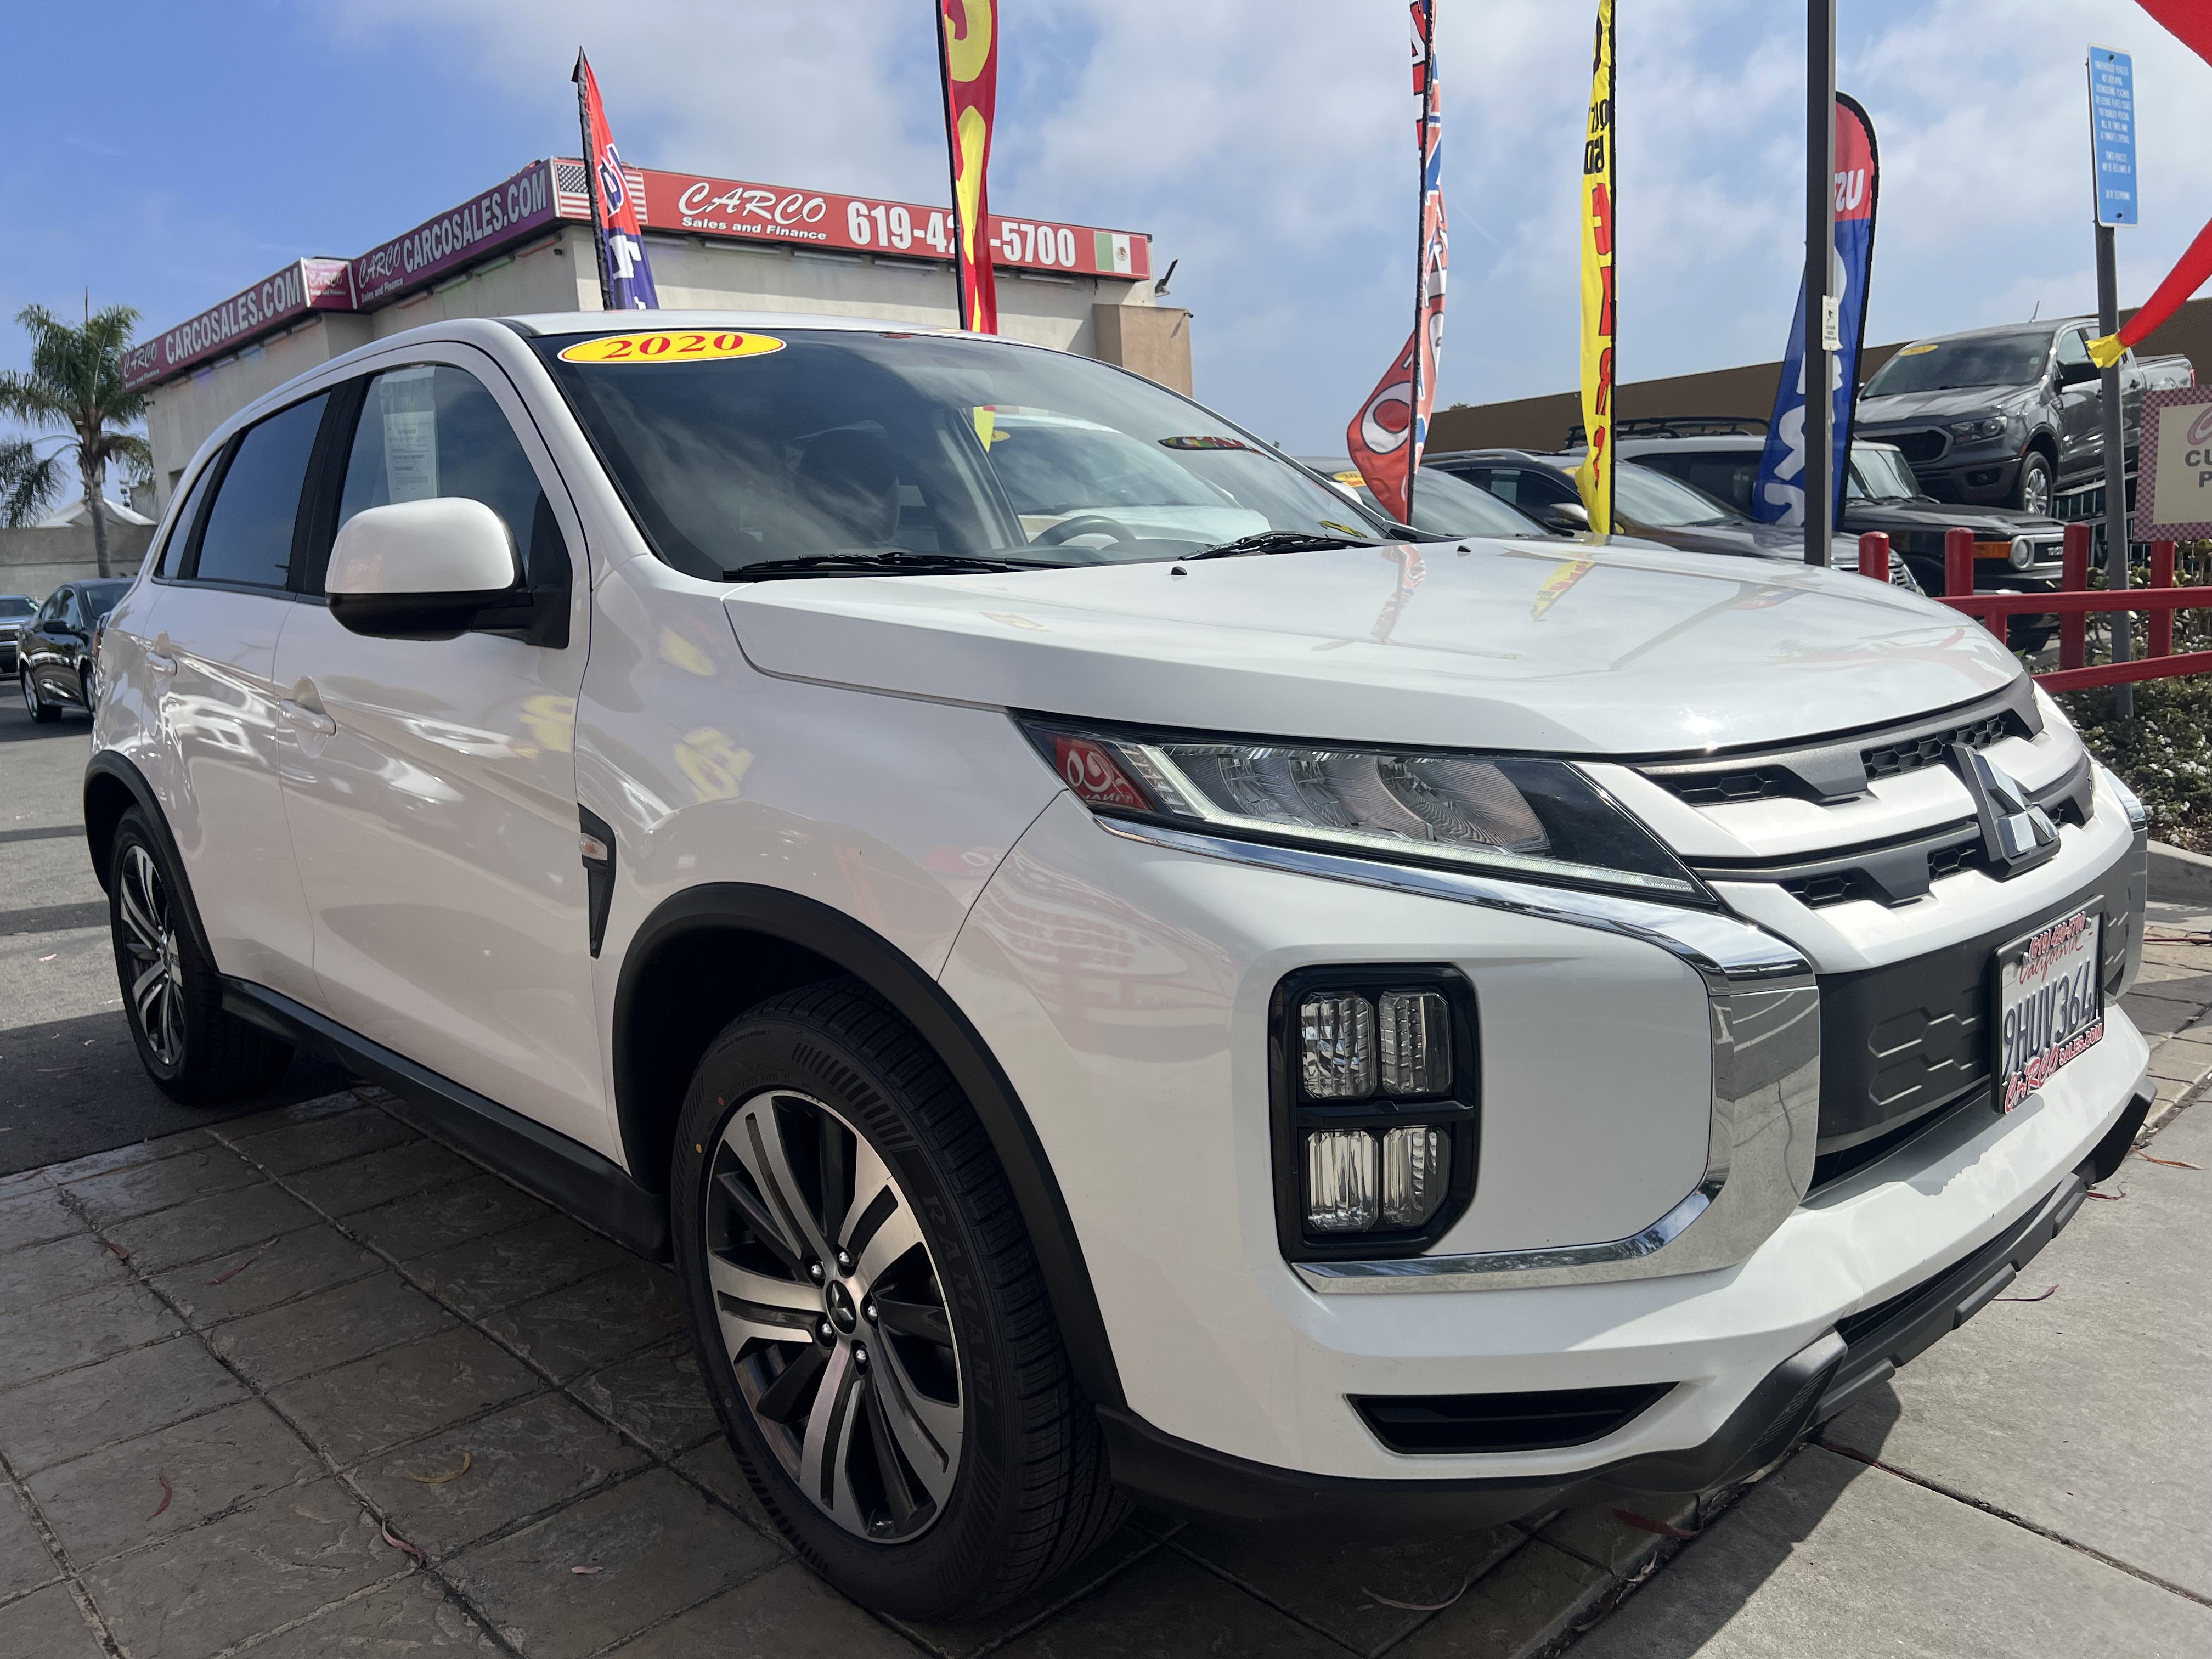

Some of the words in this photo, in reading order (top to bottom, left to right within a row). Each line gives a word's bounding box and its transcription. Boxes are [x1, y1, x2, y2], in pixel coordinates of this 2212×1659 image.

[403, 168, 548, 274] CARCOSALES.COM
[678, 182, 827, 225] CARCO
[681, 216, 727, 230] Sales
[732, 223, 762, 233] and
[766, 224, 827, 240] Finance
[847, 201, 1075, 268] 619-4-5700
[359, 242, 401, 289] CARCO
[166, 267, 300, 365] CARCOSALES.COM
[123, 342, 157, 379] CARCO
[600, 334, 743, 359] 2020
[2029, 928, 2051, 961] (619)
[2051, 911, 2086, 947] 420-5700
[2002, 960, 2094, 1079] 9HUV364
